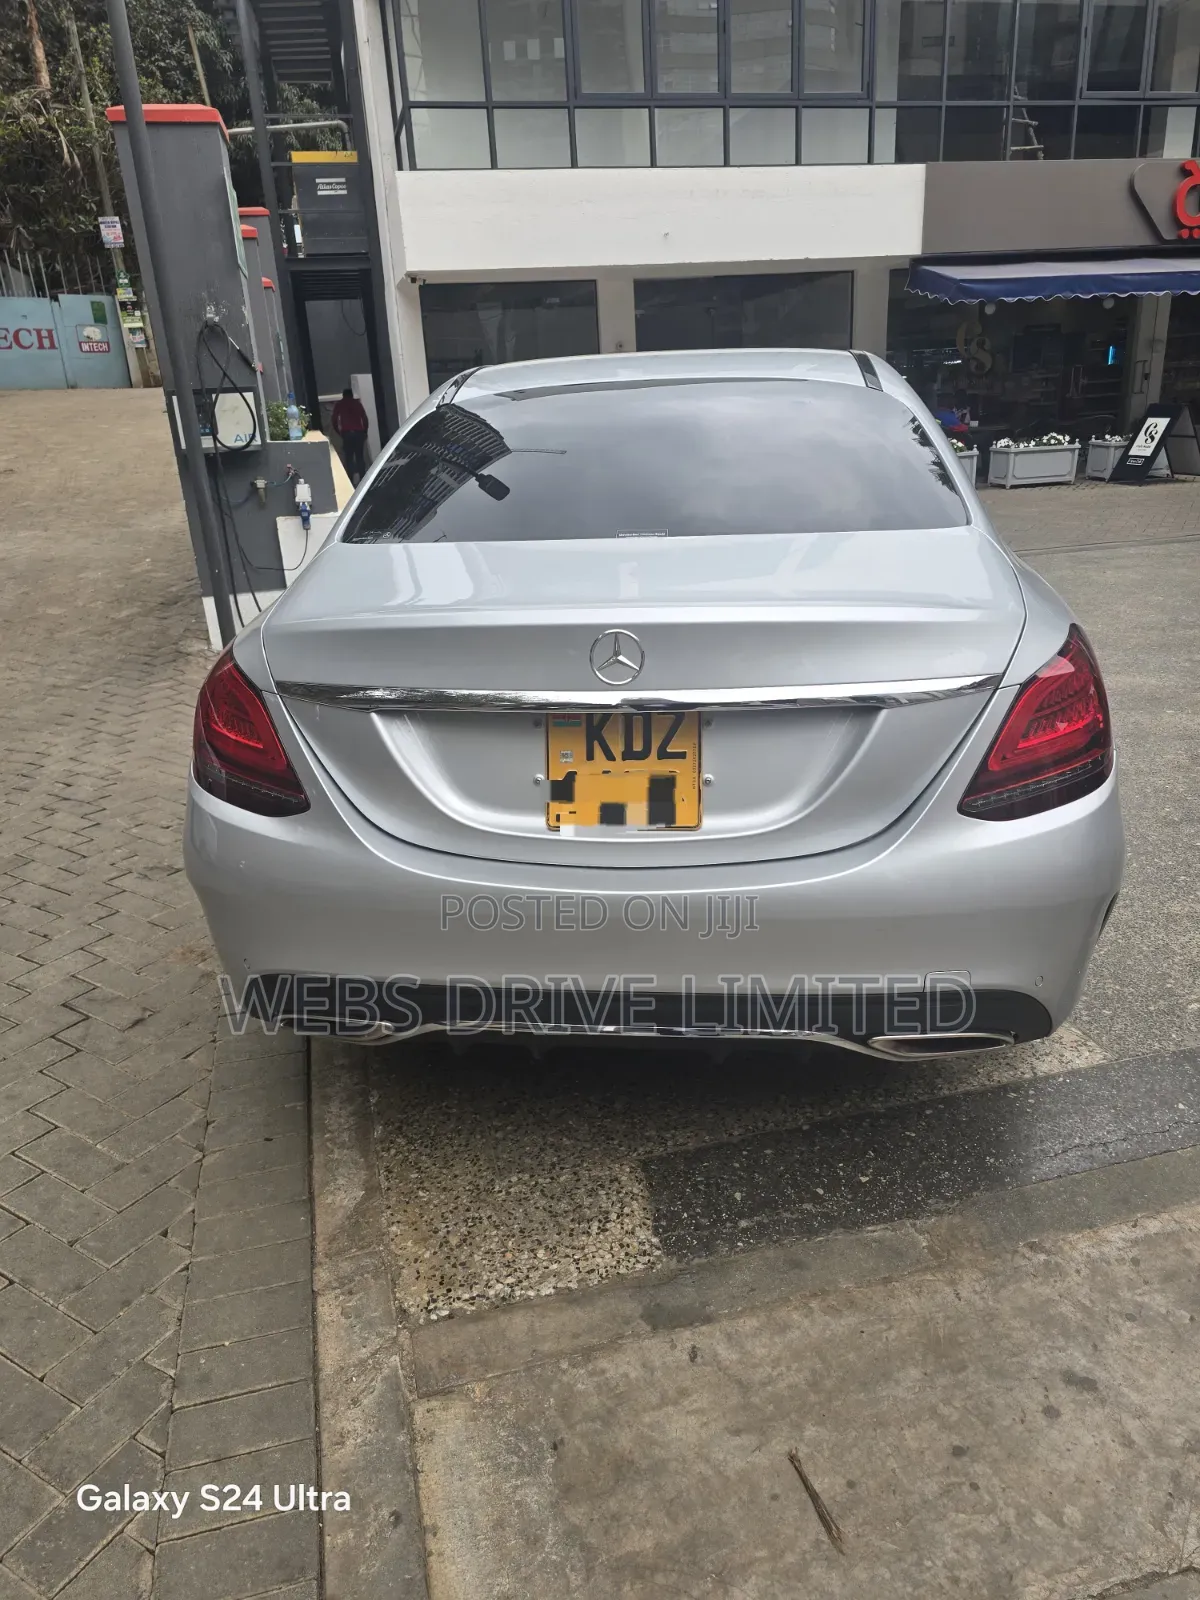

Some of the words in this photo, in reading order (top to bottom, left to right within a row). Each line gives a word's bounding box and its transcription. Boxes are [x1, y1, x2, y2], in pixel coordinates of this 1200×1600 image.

[81, 342, 109, 352] INTECH
[234, 434, 258, 443] AIR
[586, 712, 687, 762] KDZ
